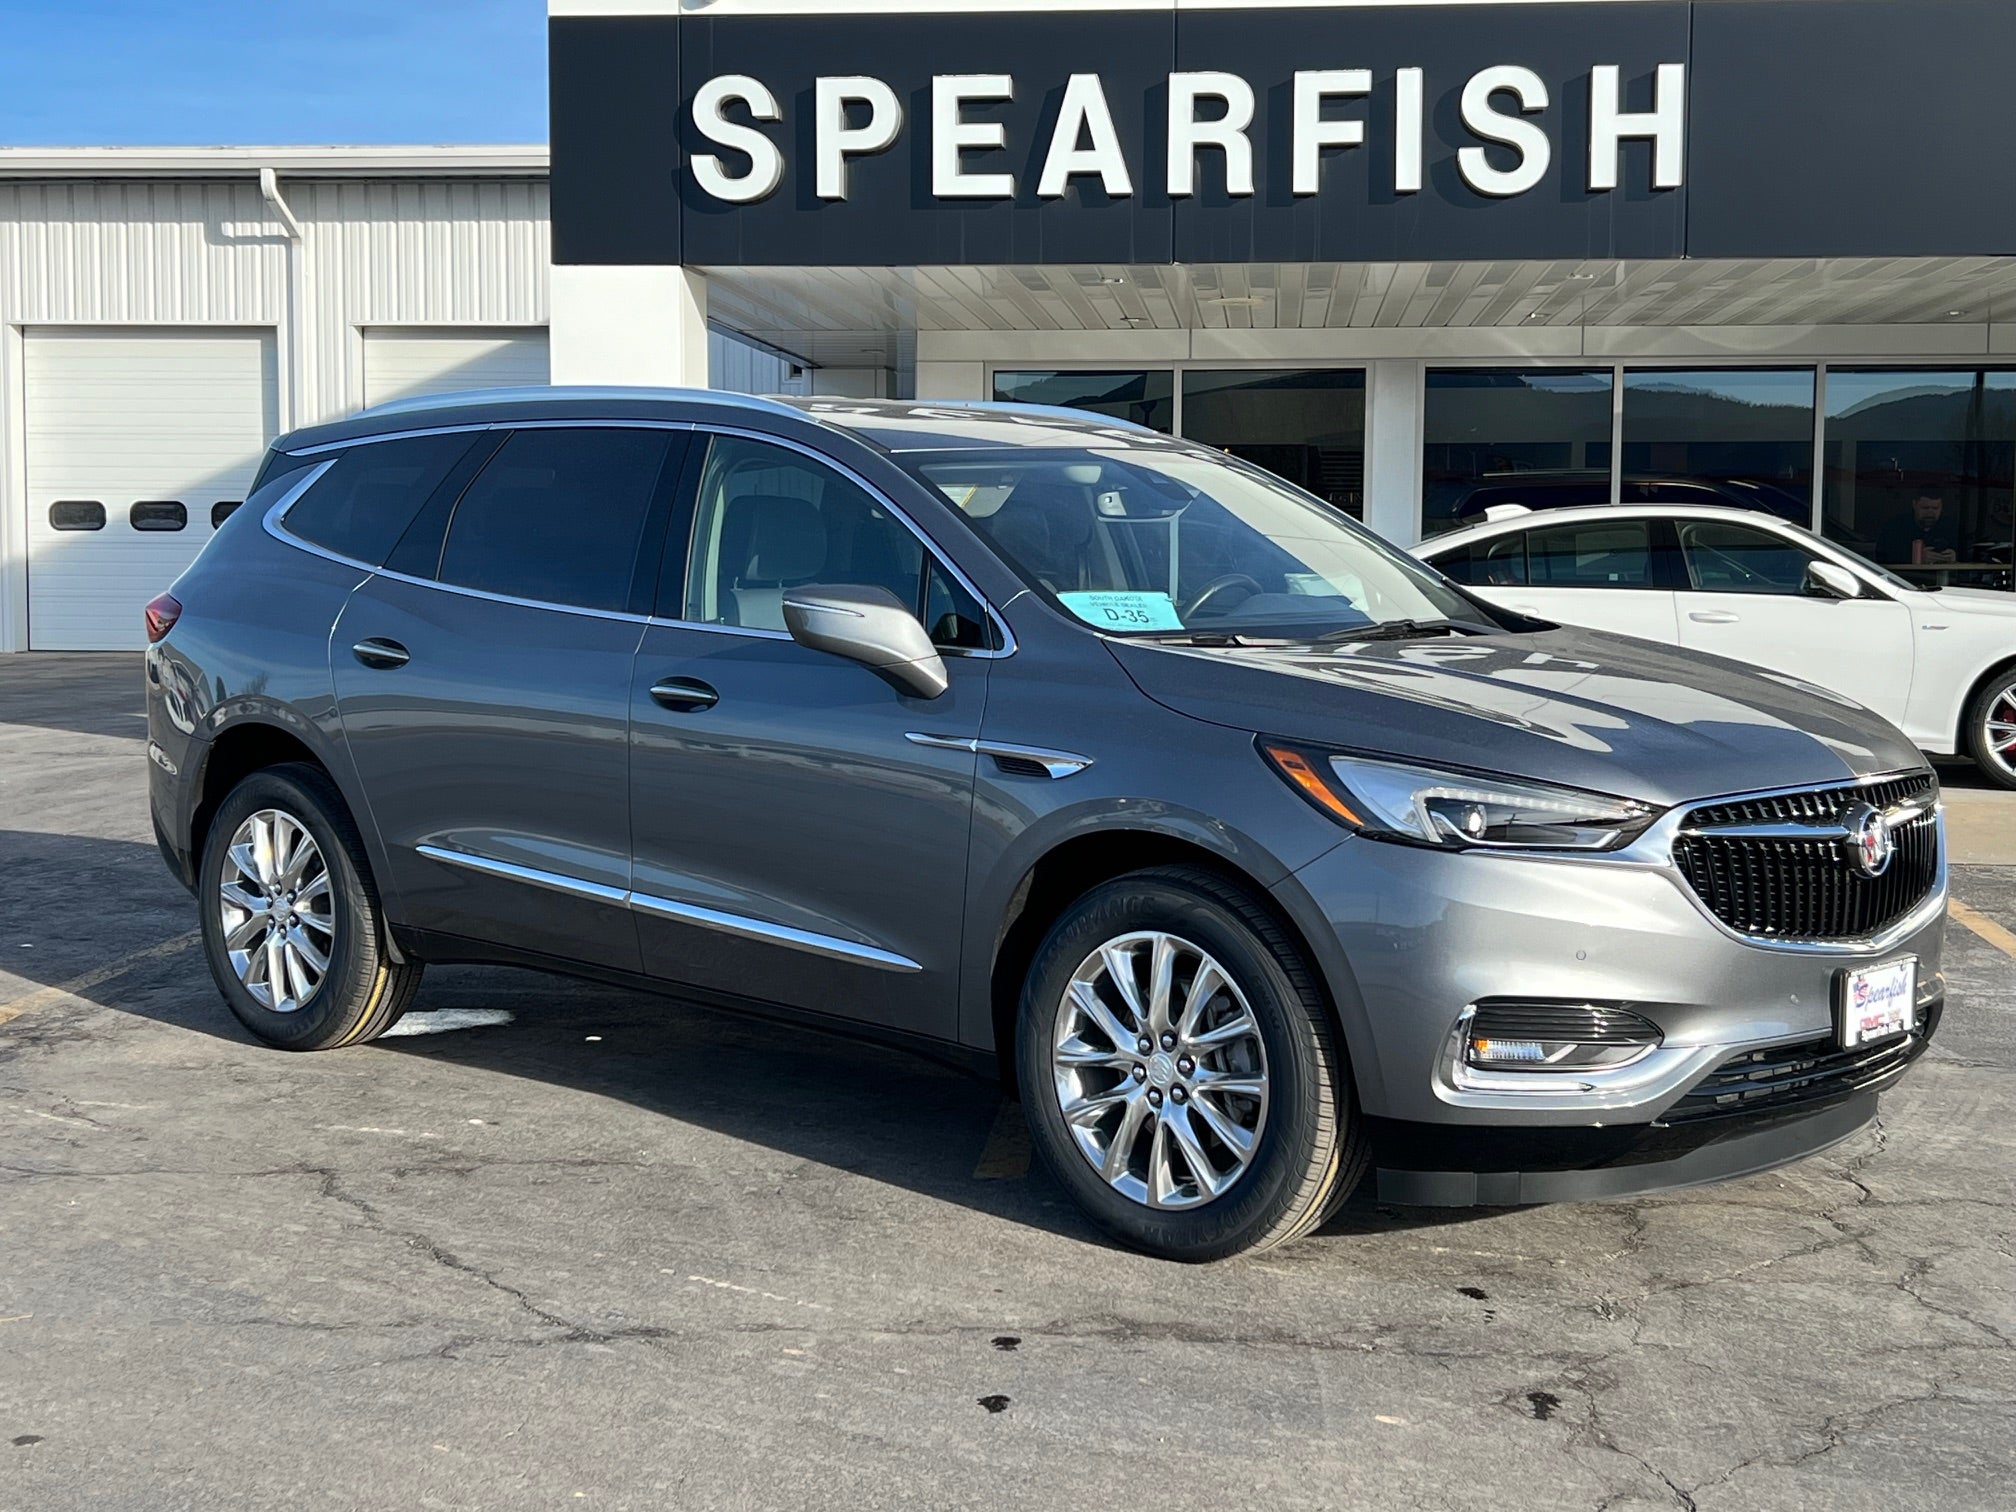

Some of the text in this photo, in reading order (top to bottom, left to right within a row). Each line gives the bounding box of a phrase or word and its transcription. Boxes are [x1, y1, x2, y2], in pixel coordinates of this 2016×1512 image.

[690, 63, 1686, 201] SPEARFISH
[1103, 608, 1150, 623] D-35
[1856, 971, 1907, 1011] Spearfish
